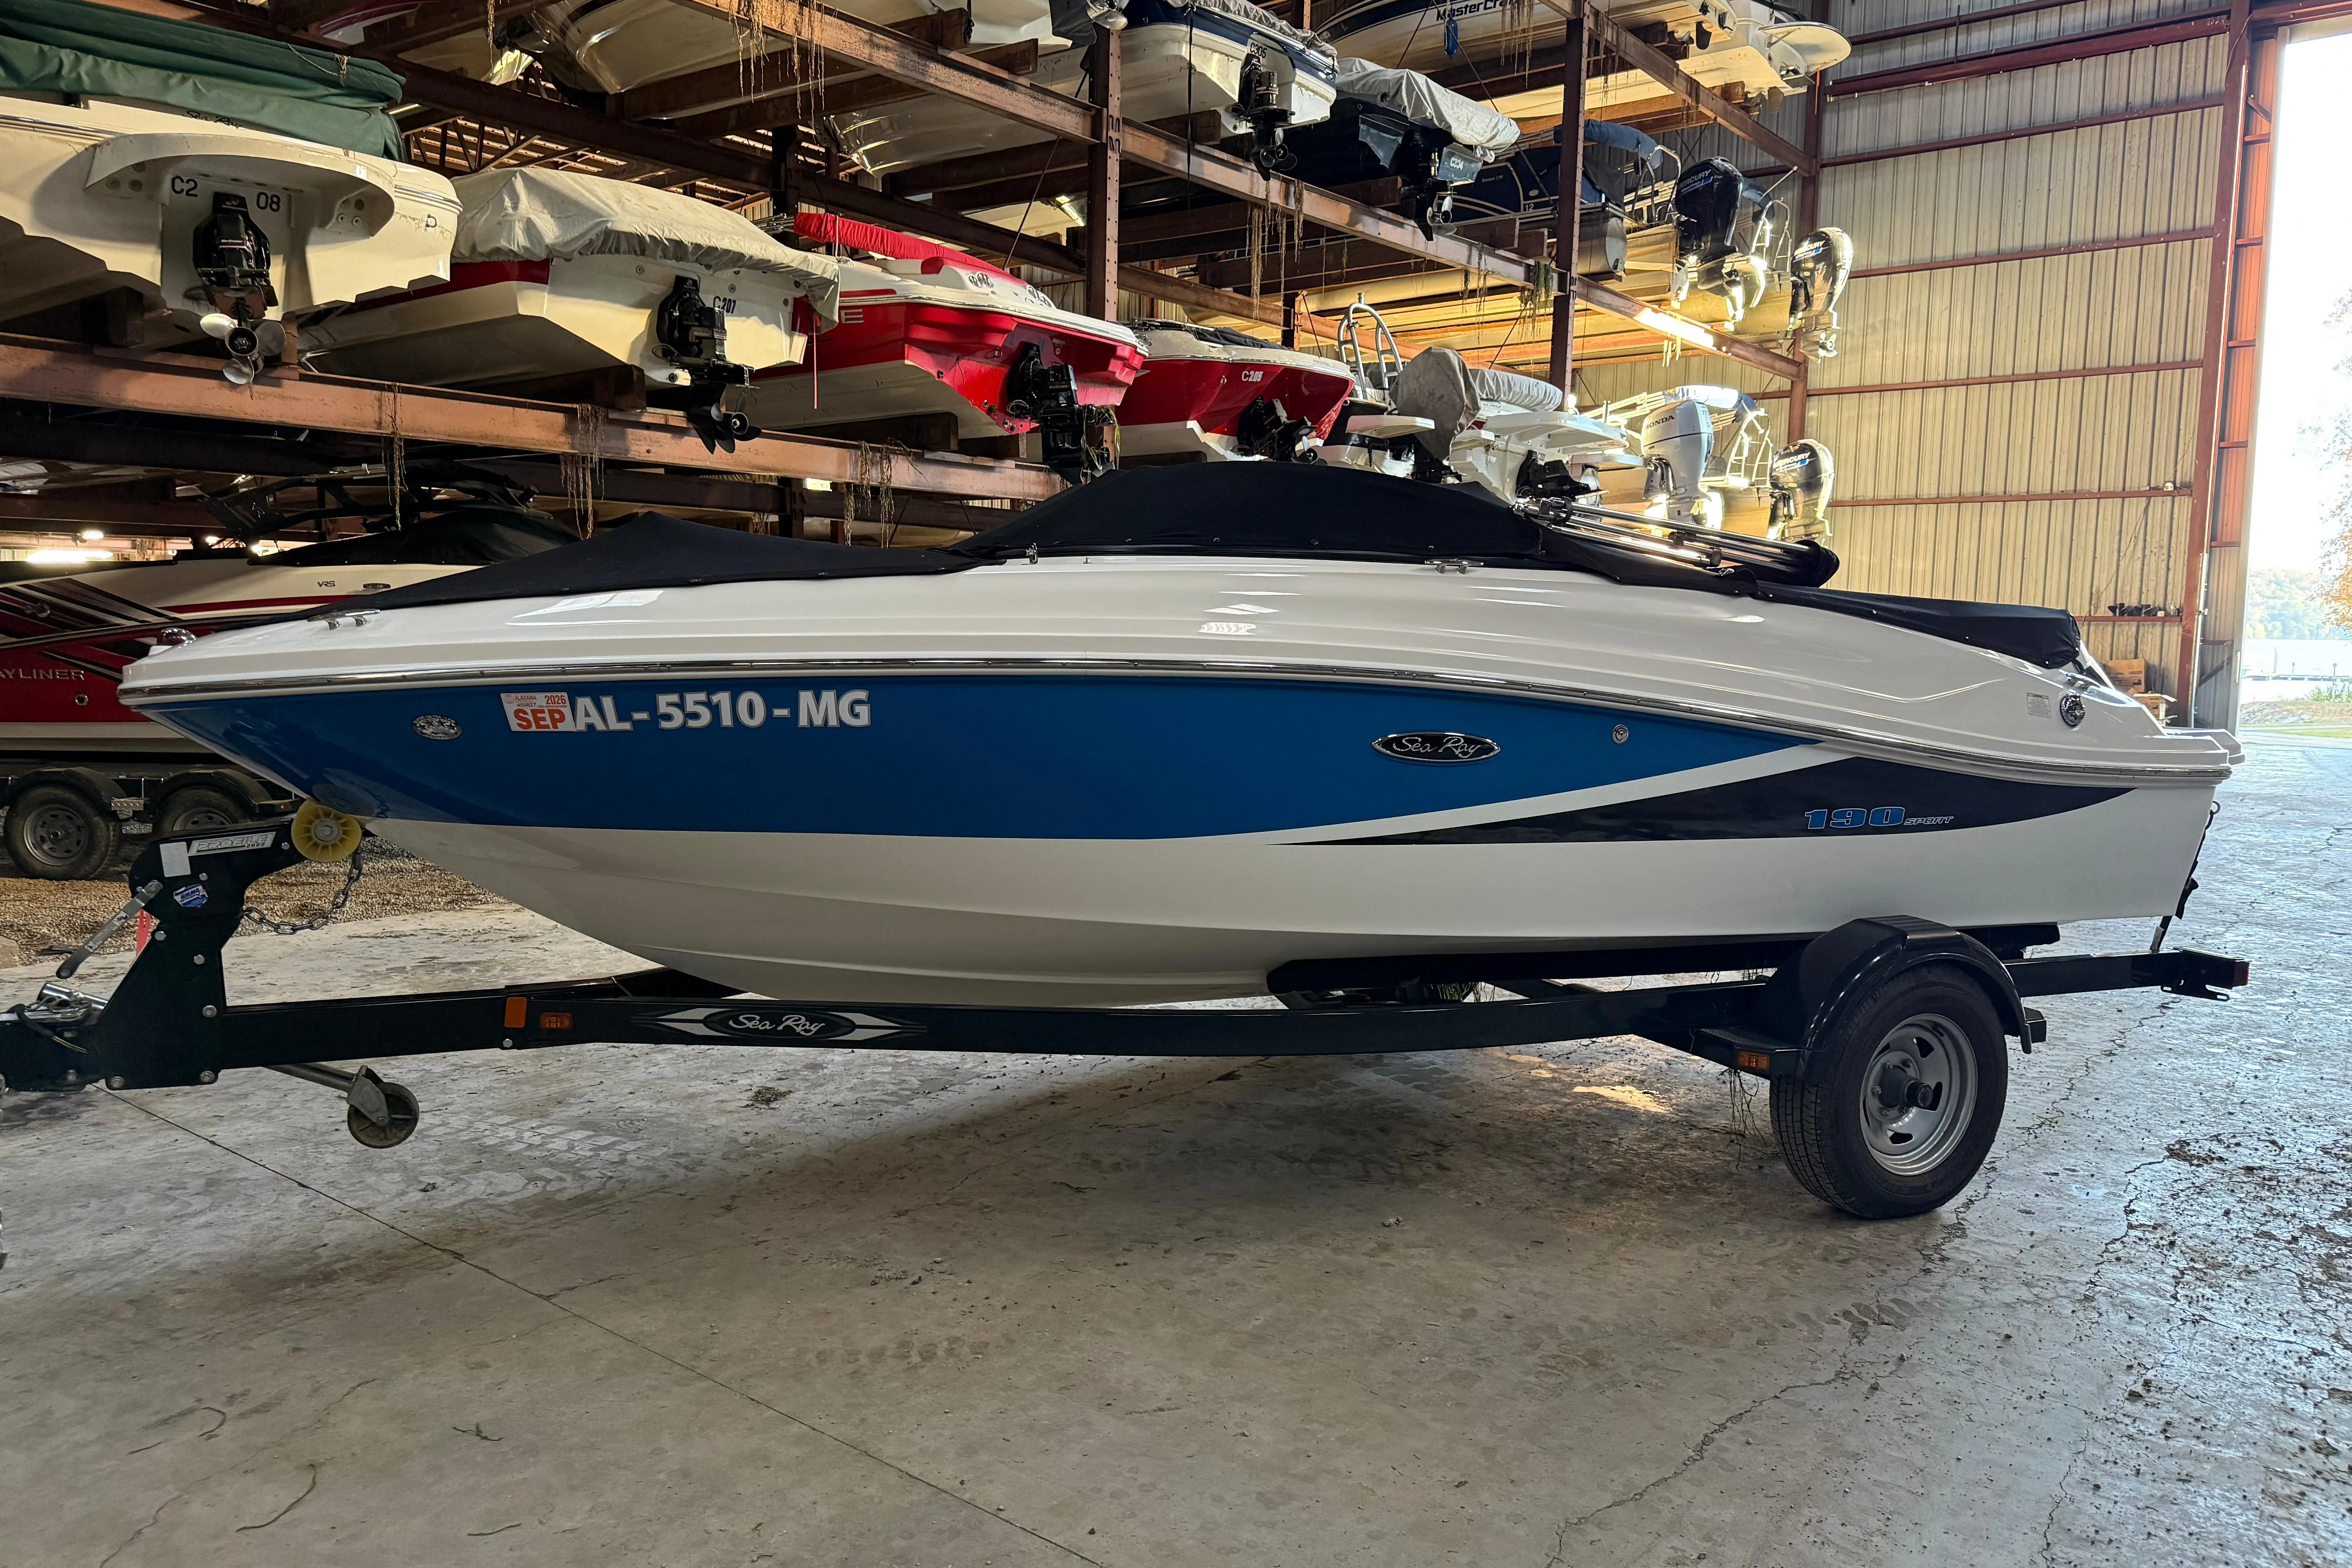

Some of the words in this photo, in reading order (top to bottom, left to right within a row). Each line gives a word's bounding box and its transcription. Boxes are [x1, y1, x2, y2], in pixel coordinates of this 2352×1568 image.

[1250, 42, 1267, 58] C305
[1450, 157, 1464, 170] C304
[171, 175, 198, 198] C2
[256, 191, 281, 212] 08
[1525, 203, 1534, 212] 12
[713, 296, 737, 314] C207
[1241, 371, 1263, 382] C205
[544, 695, 566, 705] 2026
[513, 708, 565, 730] SEP
[1393, 737, 1435, 752] Sea
[1438, 736, 1482, 758] Ray
[1805, 807, 1905, 829] 190
[1903, 816, 1954, 826] SPORT
[728, 1015, 776, 1030] Sea
[777, 1015, 826, 1036] Ray
